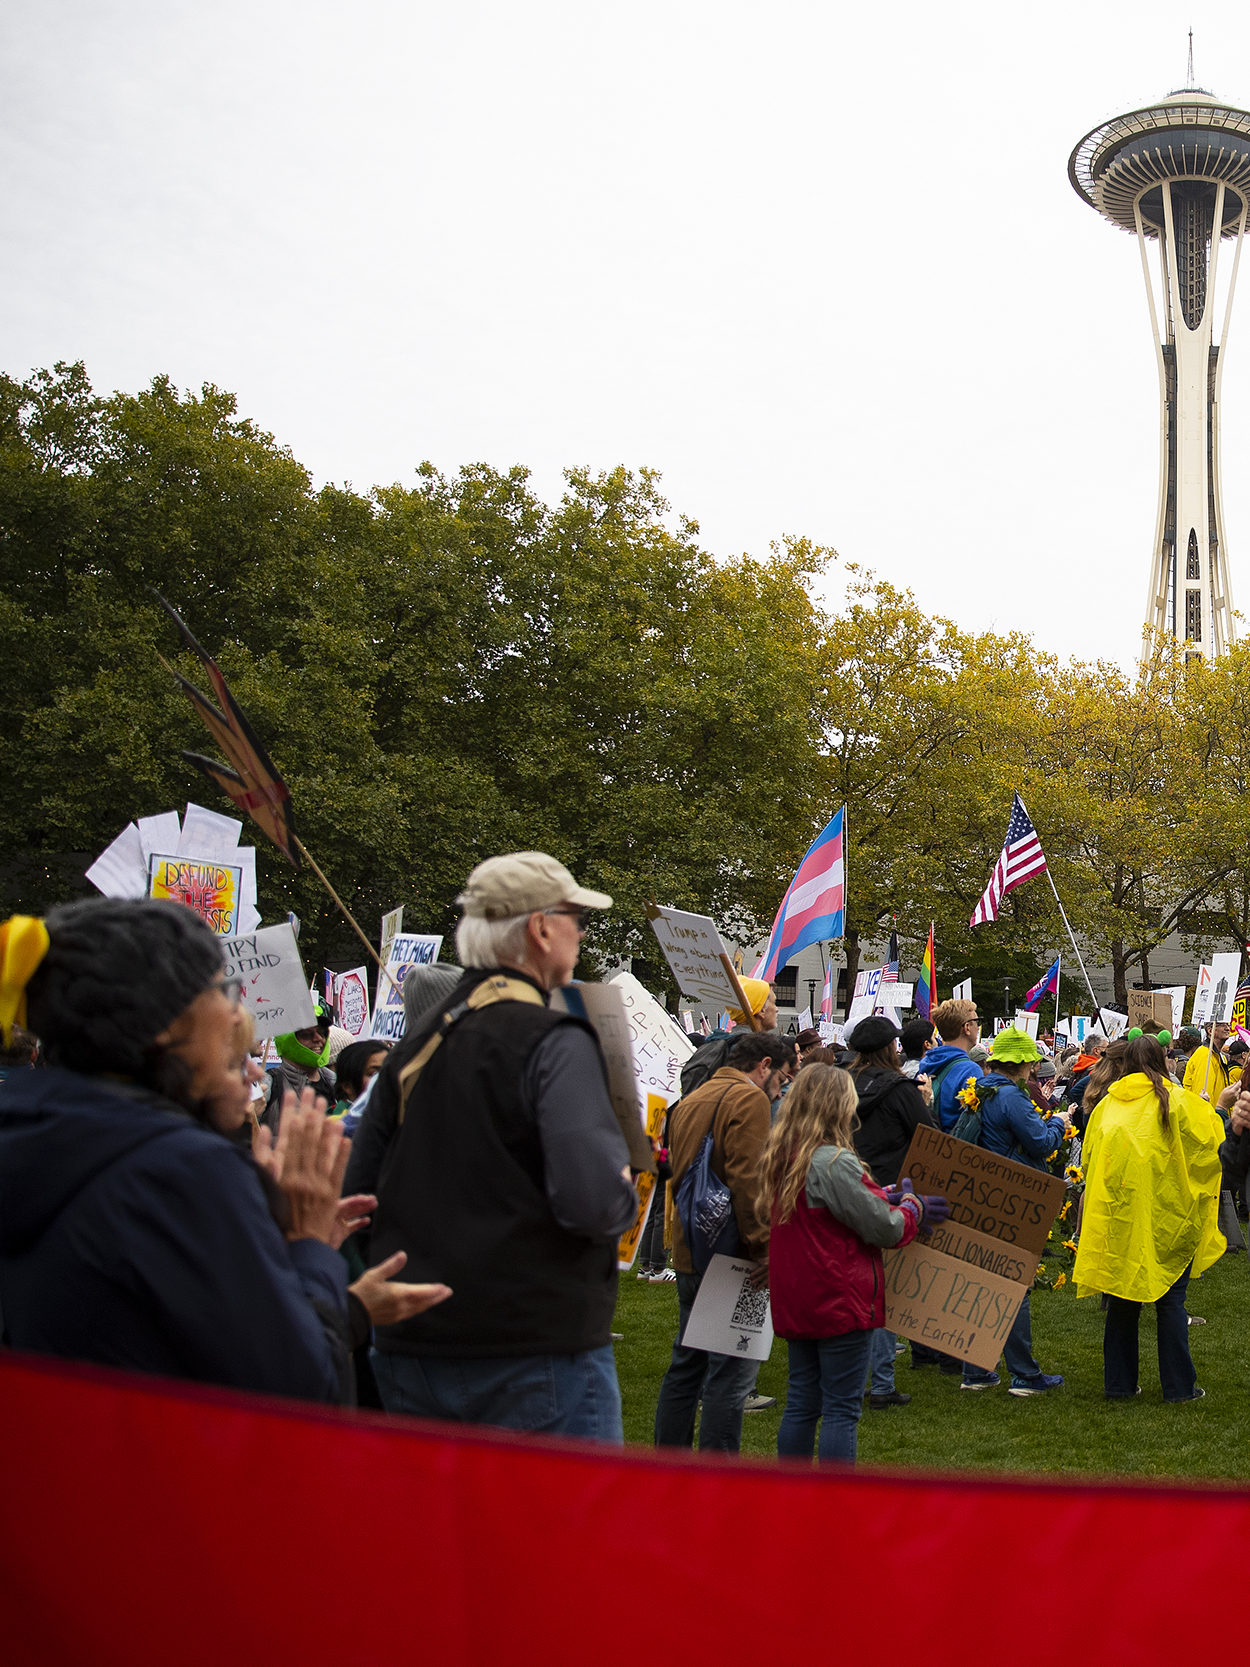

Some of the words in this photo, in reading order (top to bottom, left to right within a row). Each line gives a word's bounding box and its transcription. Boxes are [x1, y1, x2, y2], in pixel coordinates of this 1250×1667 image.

[165, 861, 228, 890] DEFUND
[179, 889, 212, 910] THE
[194, 908, 233, 934] ISTS
[660, 916, 699, 943] Trump
[700, 929, 708, 938] is
[223, 936, 258, 958] TRY
[238, 954, 281, 973] FIND
[371, 1008, 406, 1039] YOURSEL
[1232, 1002, 1245, 1015] ND
[916, 1127, 957, 1160] THIS
[959, 1145, 1051, 1195] Government
[929, 1170, 946, 1189] the
[945, 1170, 1046, 1225] FASCISTS
[949, 1201, 1020, 1244] IDIOTS
[931, 1228, 1026, 1282] BILLIONAIRES
[882, 1249, 947, 1304] MUST
[941, 1272, 1022, 1342] PERISH
[899, 1308, 920, 1330] the
[921, 1317, 976, 1355] Earth!
